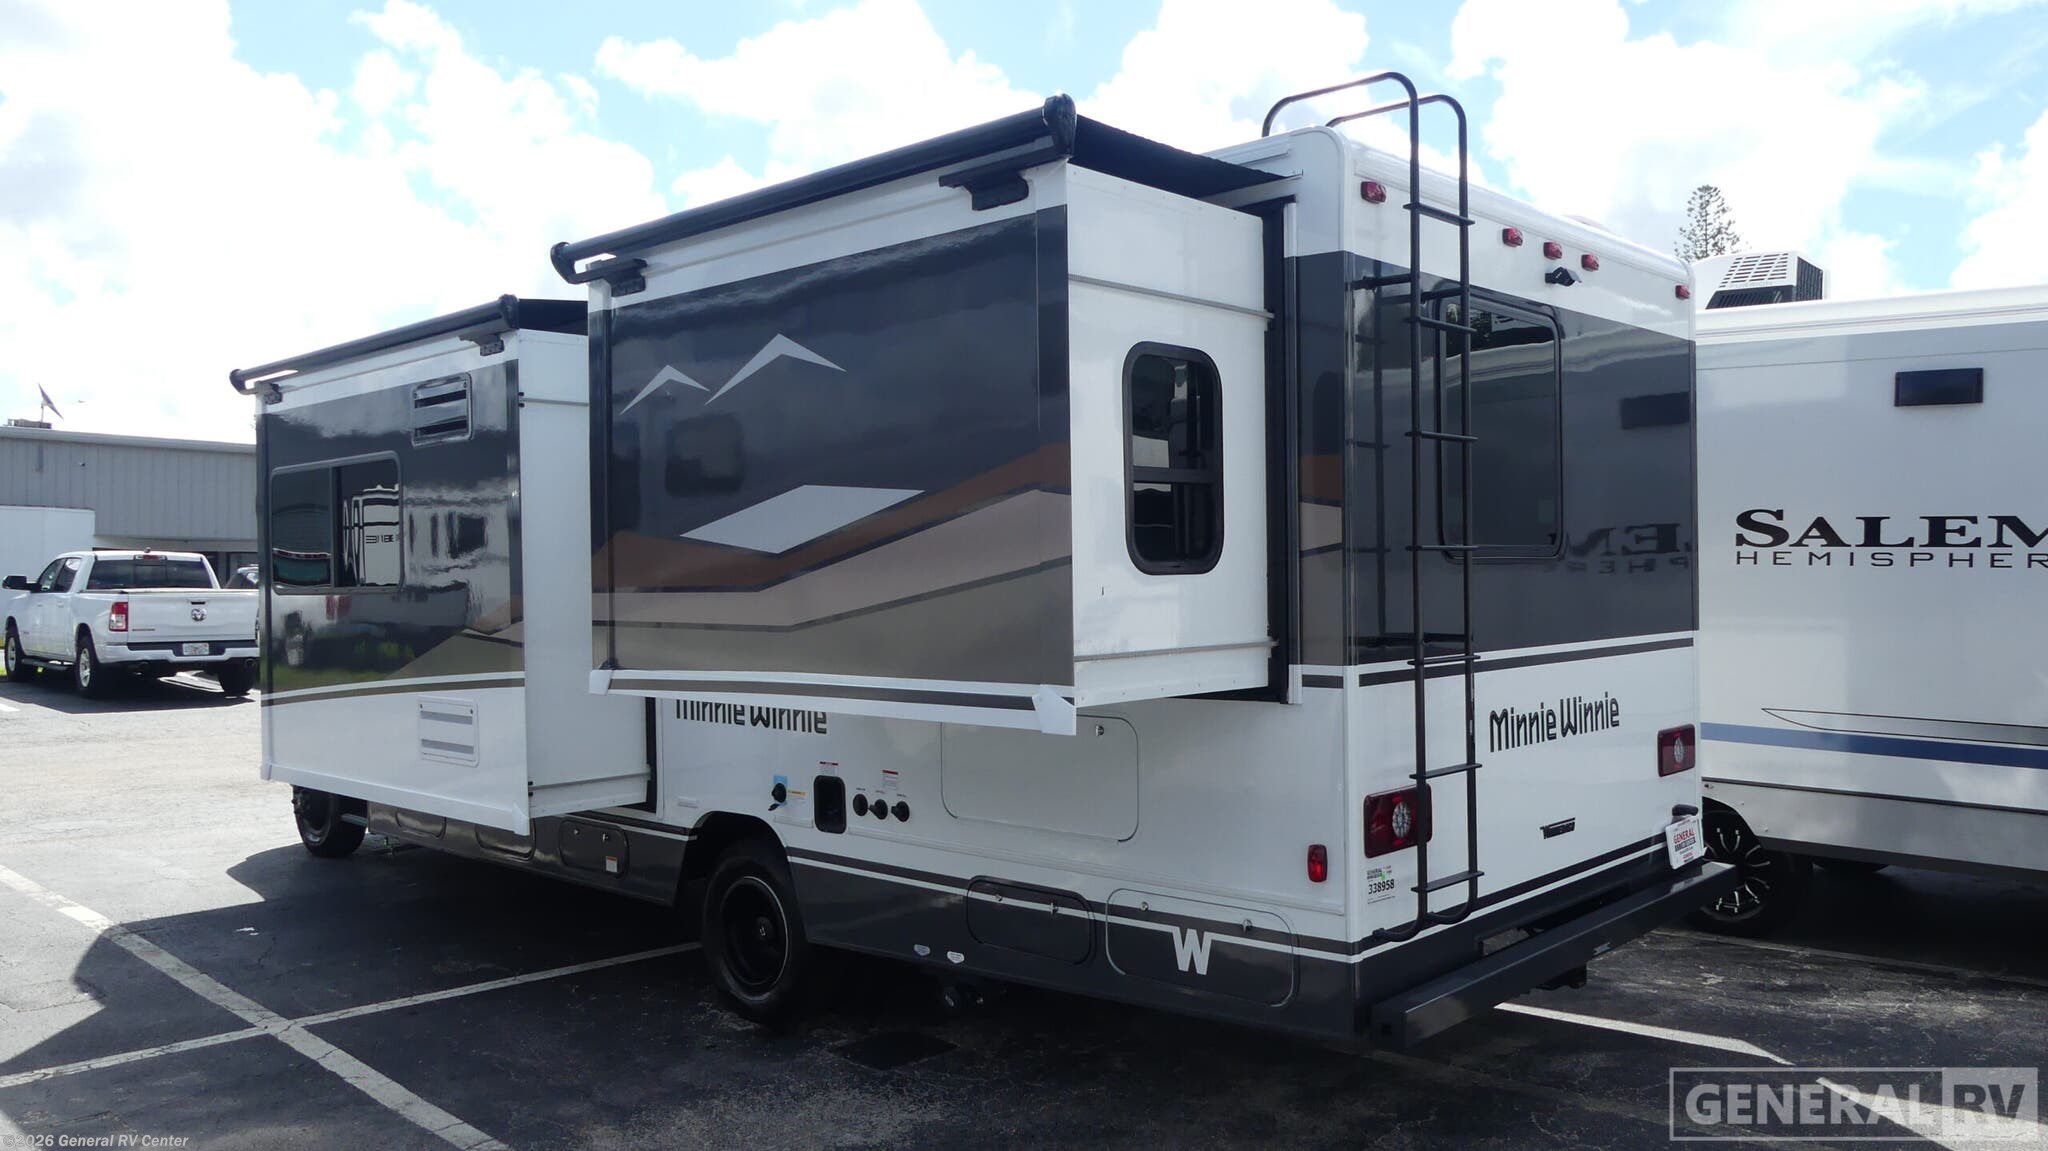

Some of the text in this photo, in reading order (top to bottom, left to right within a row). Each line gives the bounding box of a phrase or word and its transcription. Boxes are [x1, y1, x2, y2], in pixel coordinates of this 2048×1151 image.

[1736, 508, 2048, 548] SALEM
[1489, 691, 1620, 753] Minnie Winnie
[1673, 828, 1695, 844] GENERAL
[1368, 879, 1395, 895] 338958
[1172, 926, 1212, 976] W
